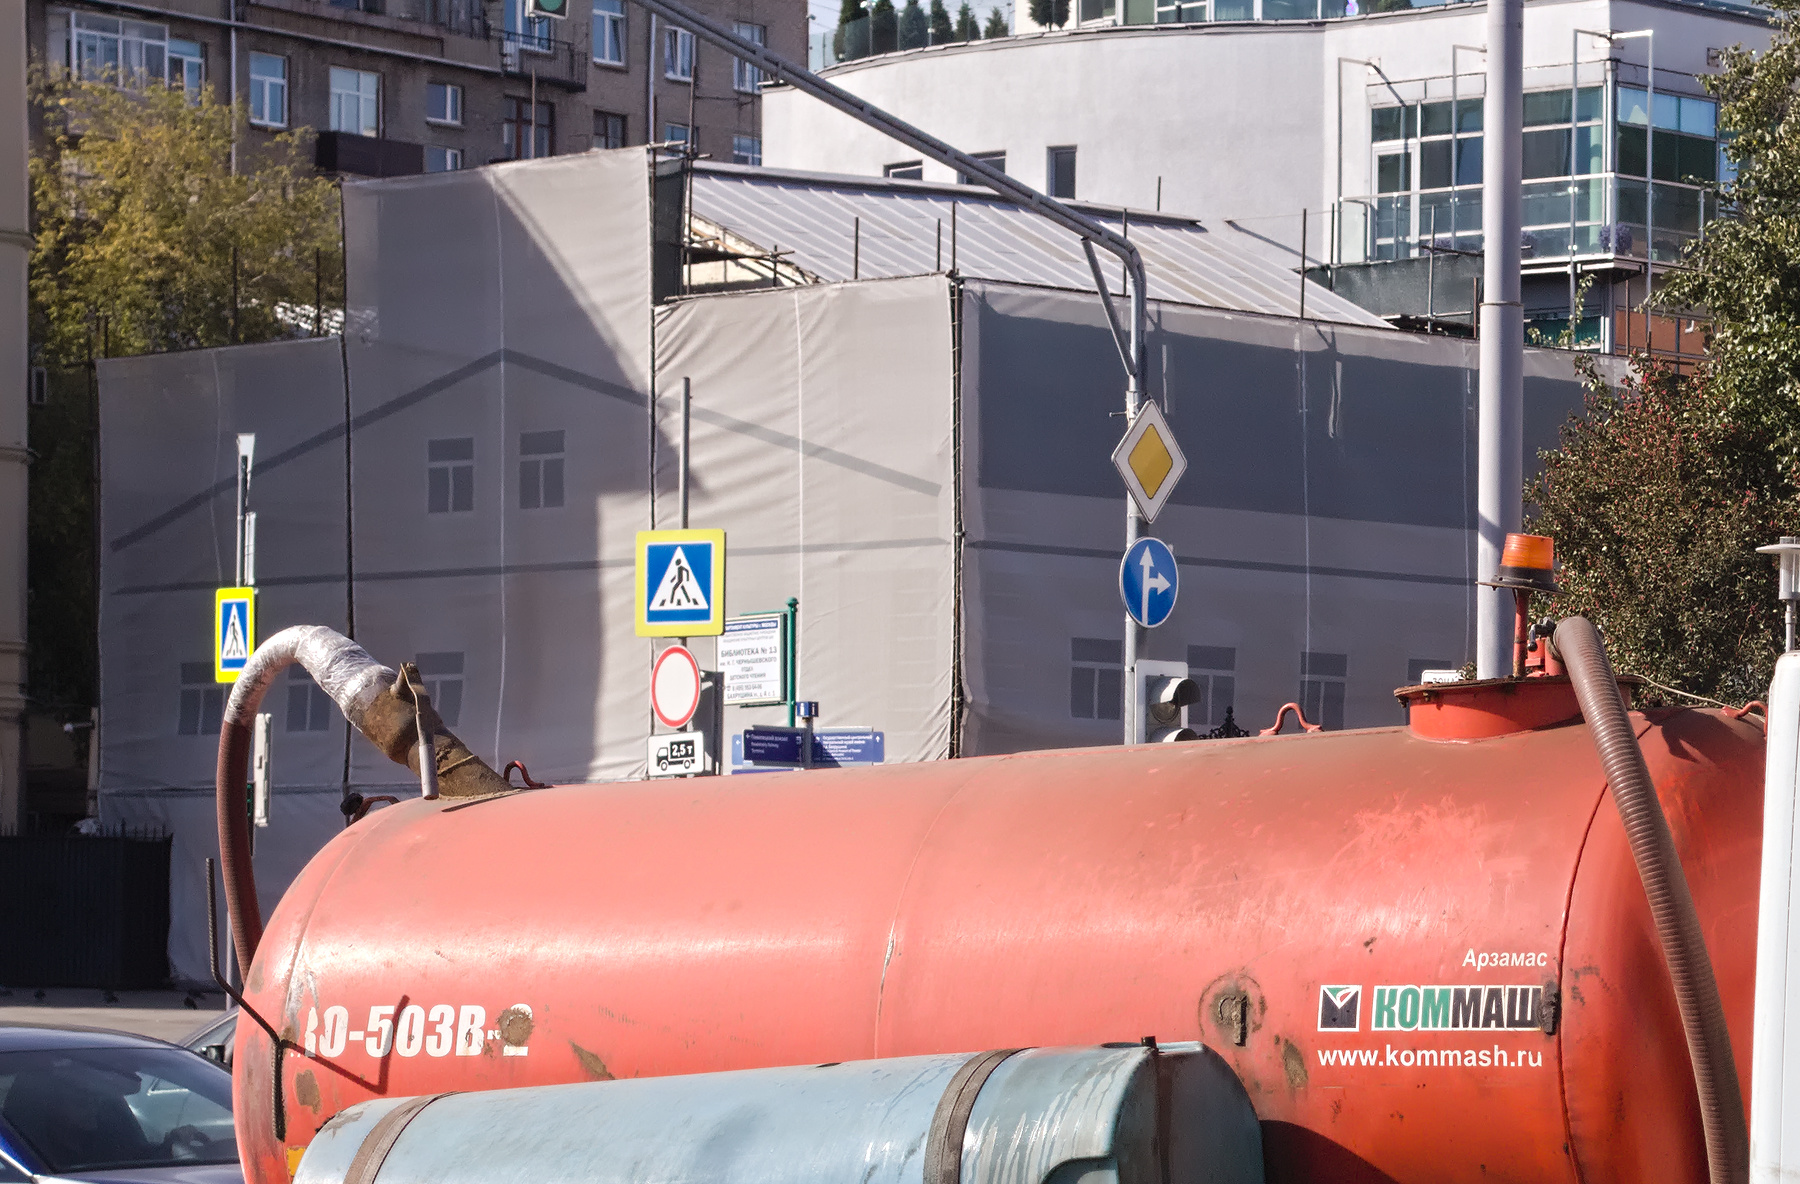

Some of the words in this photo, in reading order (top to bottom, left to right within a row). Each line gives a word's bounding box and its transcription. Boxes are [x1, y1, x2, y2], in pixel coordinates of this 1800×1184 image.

[721, 647, 759, 657] БИБЛИОТЕКА
[1462, 948, 1548, 972] Арзамас
[1372, 984, 1546, 1032] КОММАШ
[1318, 1045, 1544, 1068] www.kommash.ru
